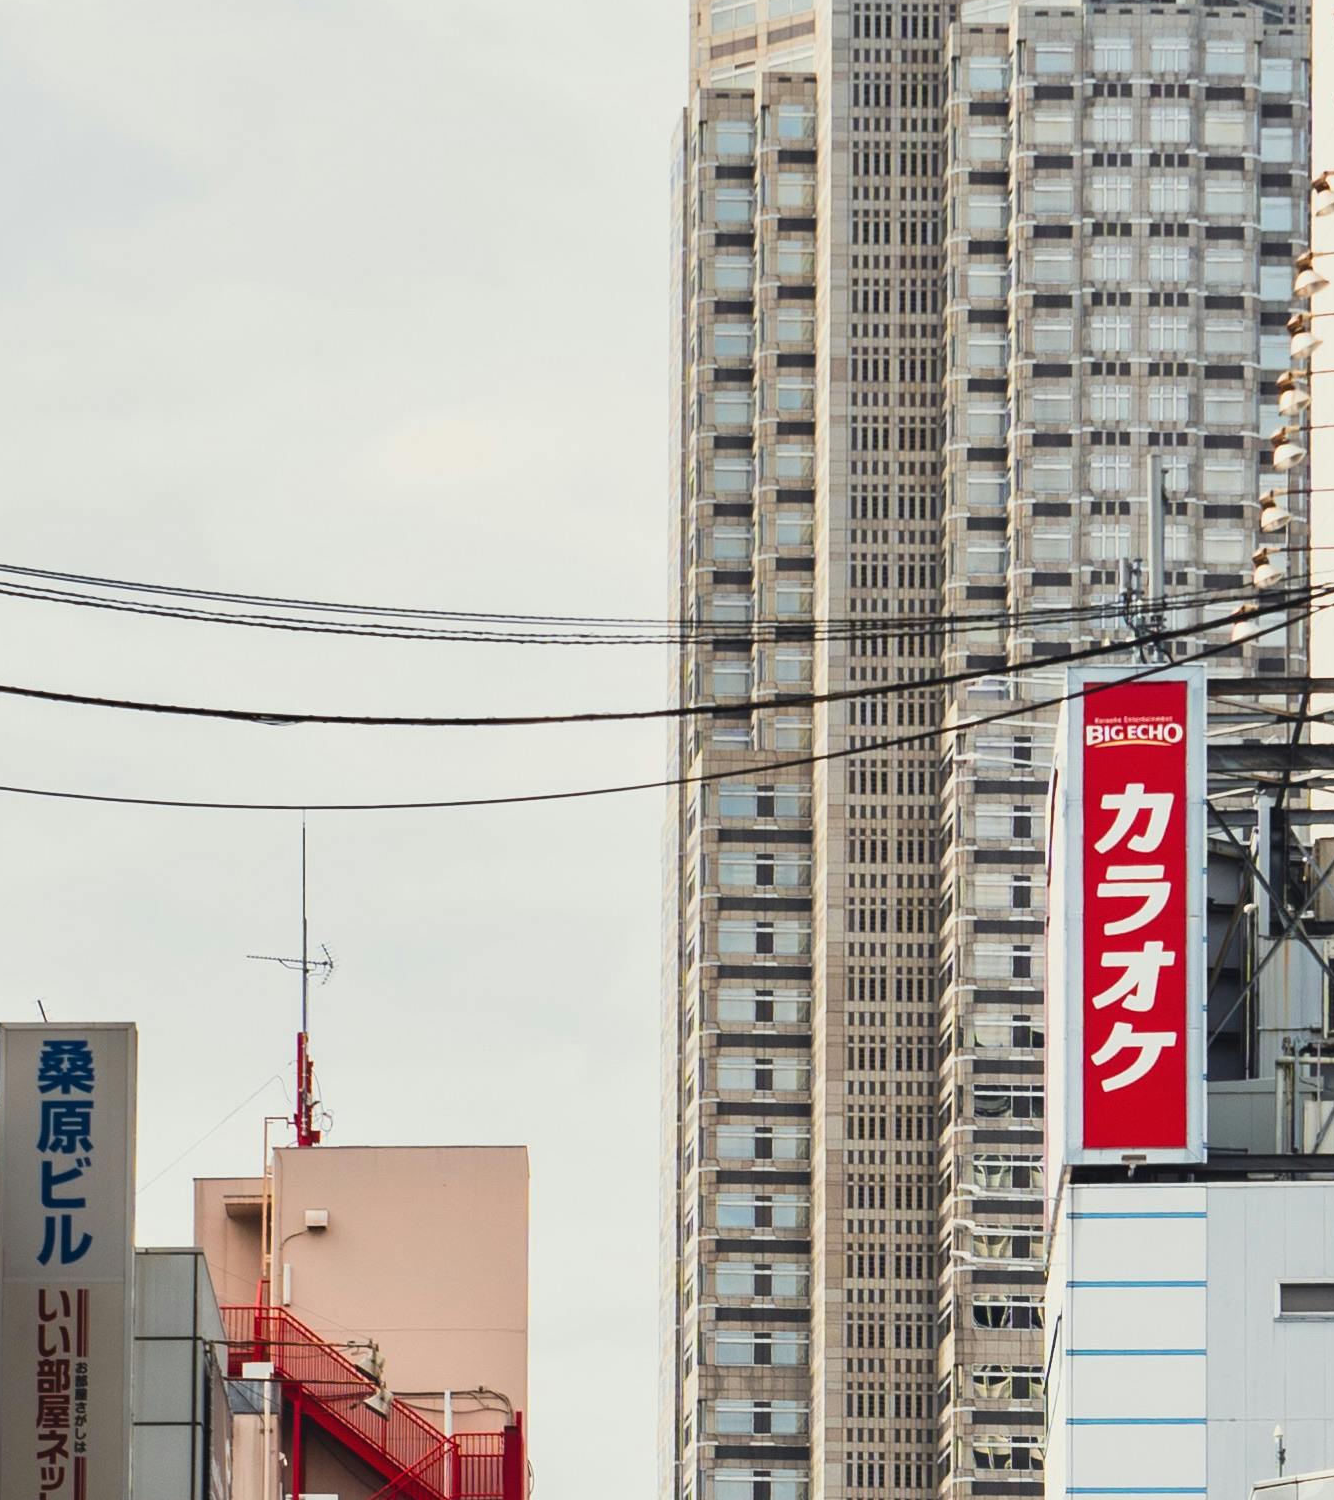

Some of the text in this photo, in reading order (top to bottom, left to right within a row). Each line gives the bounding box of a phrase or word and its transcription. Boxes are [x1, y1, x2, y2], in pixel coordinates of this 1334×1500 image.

[1085, 723, 1183, 746] BIG ECHO
[1091, 782, 1177, 1093] カラオケ
[37, 1040, 95, 1266] 桑原ビル
[74, 1362, 89, 1453] お部屋さがしは
